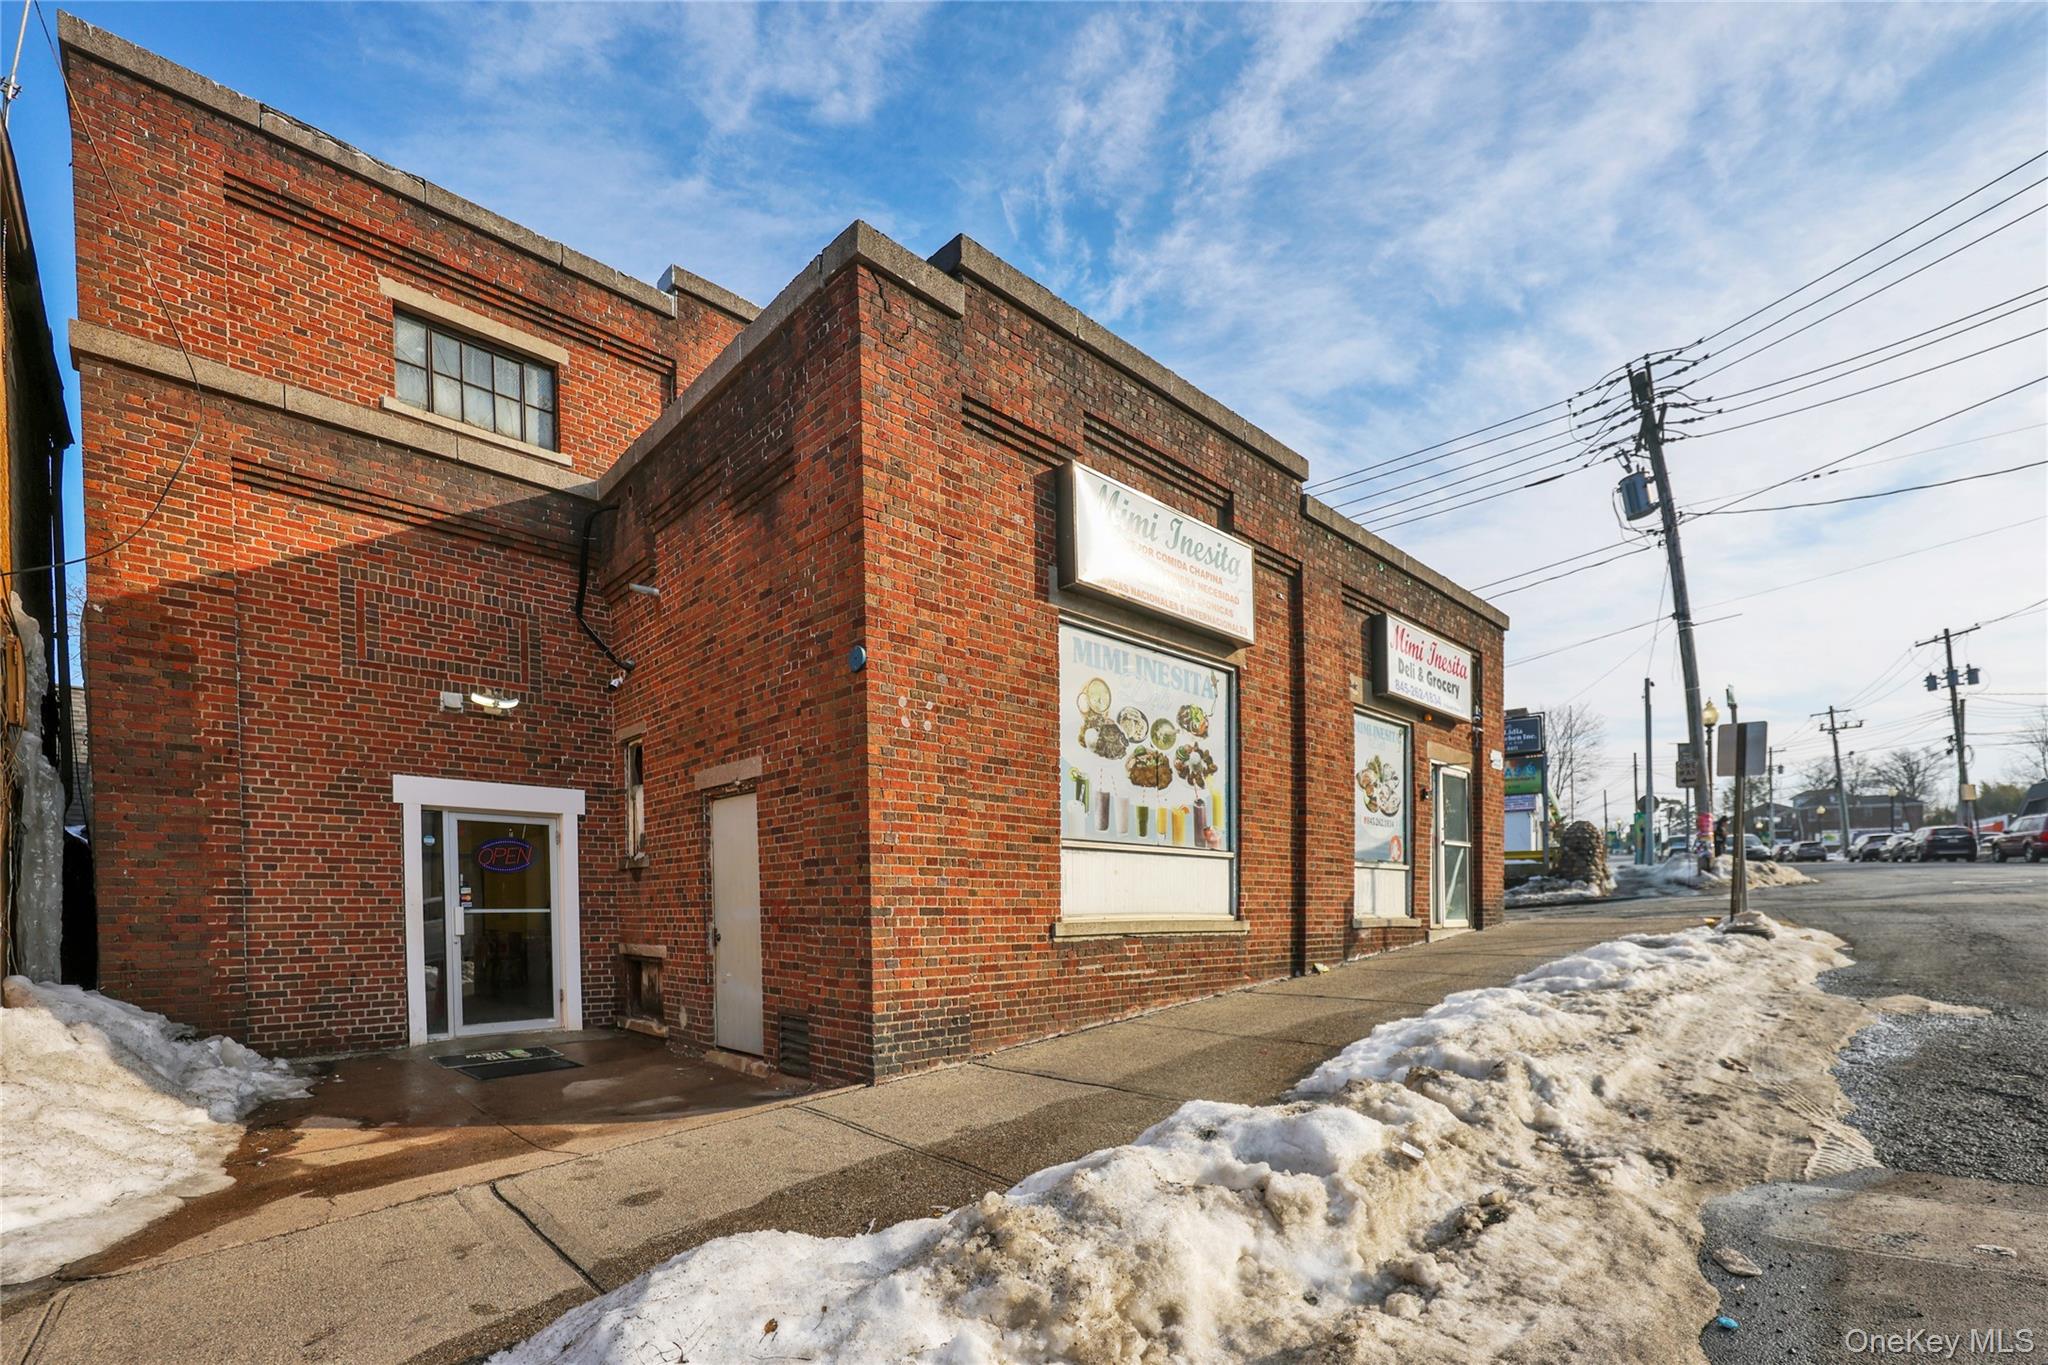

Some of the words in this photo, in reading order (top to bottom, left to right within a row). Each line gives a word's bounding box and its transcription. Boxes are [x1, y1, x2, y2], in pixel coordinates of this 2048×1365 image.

[1097, 484, 1159, 542] Mimi
[1165, 518, 1242, 576] Inesita
[1155, 551, 1188, 571] COMIDA
[1189, 565, 1223, 585] CHAPINA
[1072, 636, 1130, 675] MIMI
[1135, 655, 1214, 700] INESITA
[1390, 624, 1425, 662] Mimi
[1427, 641, 1469, 680] Inesita
[1398, 657, 1415, 680] Deli
[1417, 667, 1424, 683] &
[1426, 670, 1461, 699] Grocery
[477, 846, 533, 866] OPEN
